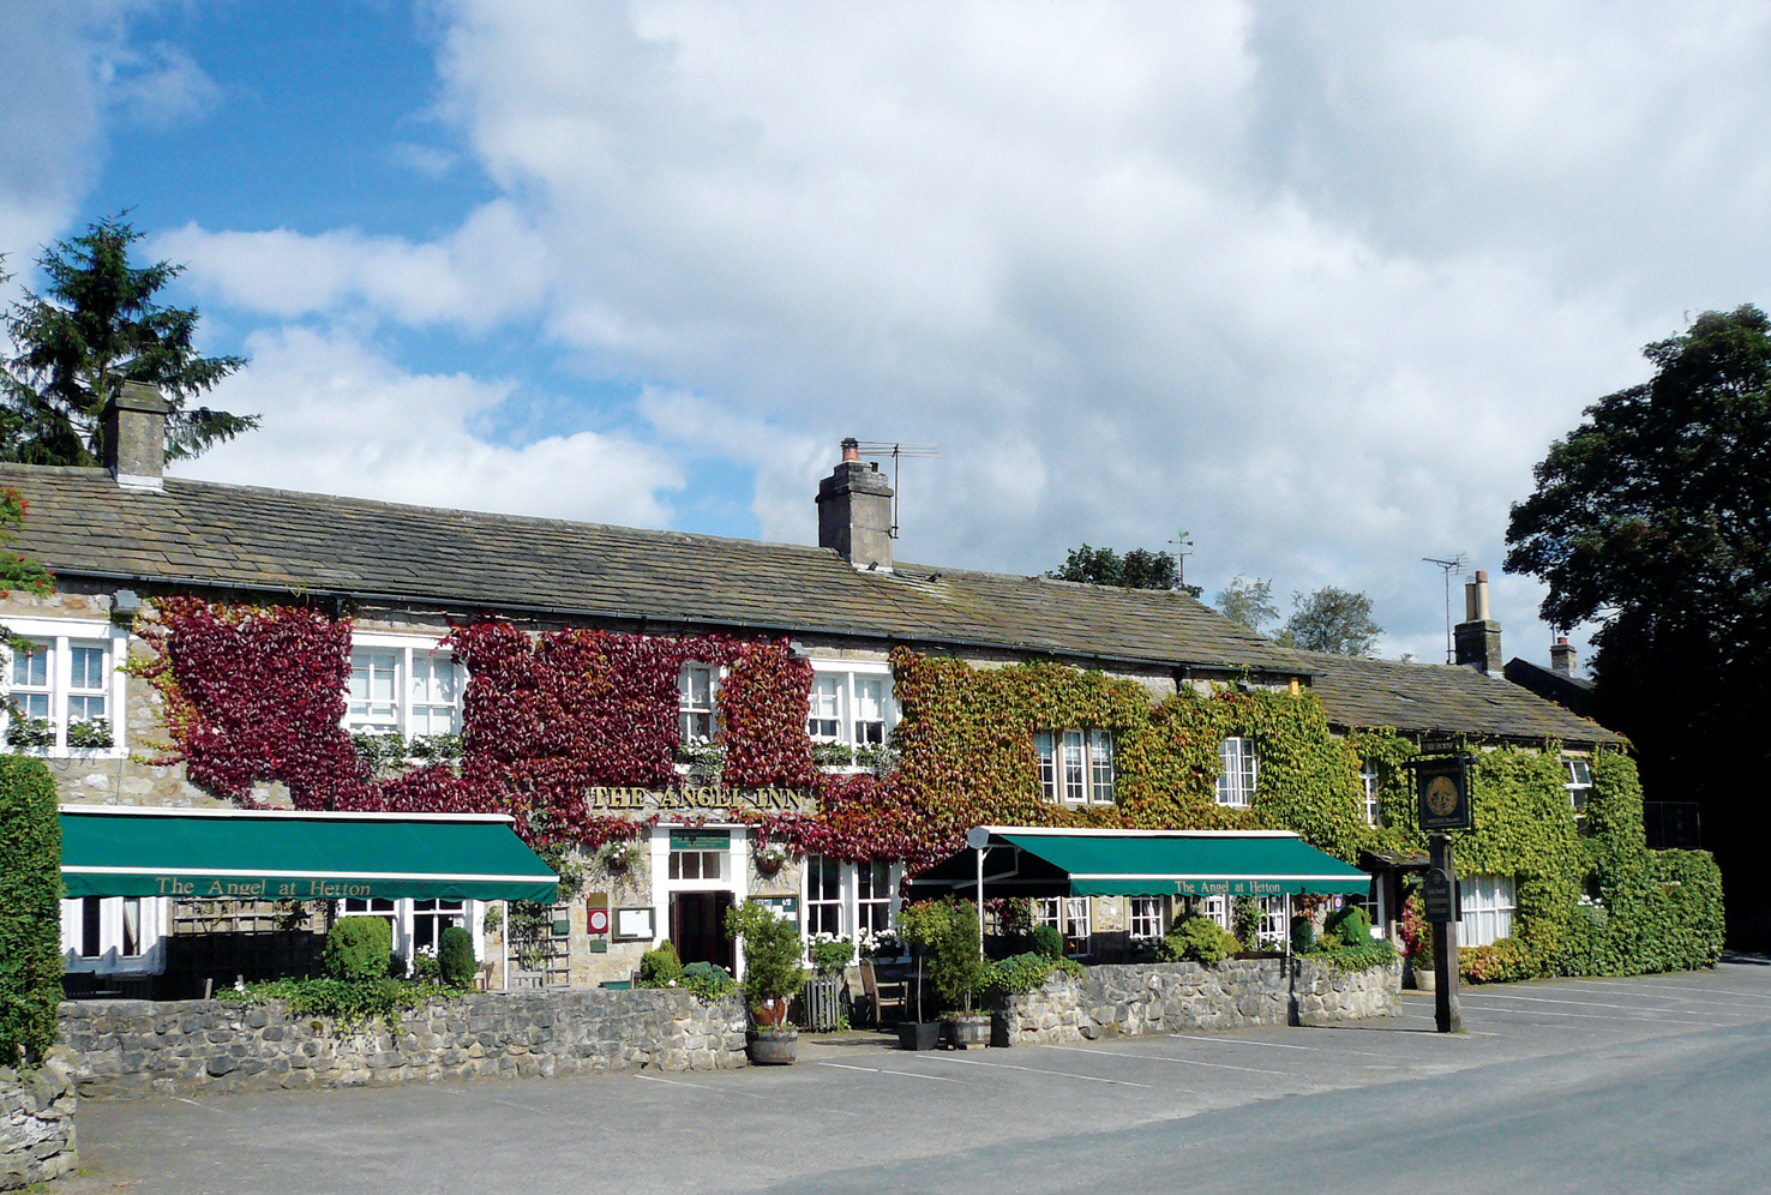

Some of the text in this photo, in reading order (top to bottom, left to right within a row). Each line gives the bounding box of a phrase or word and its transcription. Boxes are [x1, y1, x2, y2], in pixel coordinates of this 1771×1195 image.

[590, 786, 804, 808] THE ANGEL INN
[155, 877, 371, 896] The Angel at Hetton
[1175, 880, 1280, 895] The Angel at Hetton
